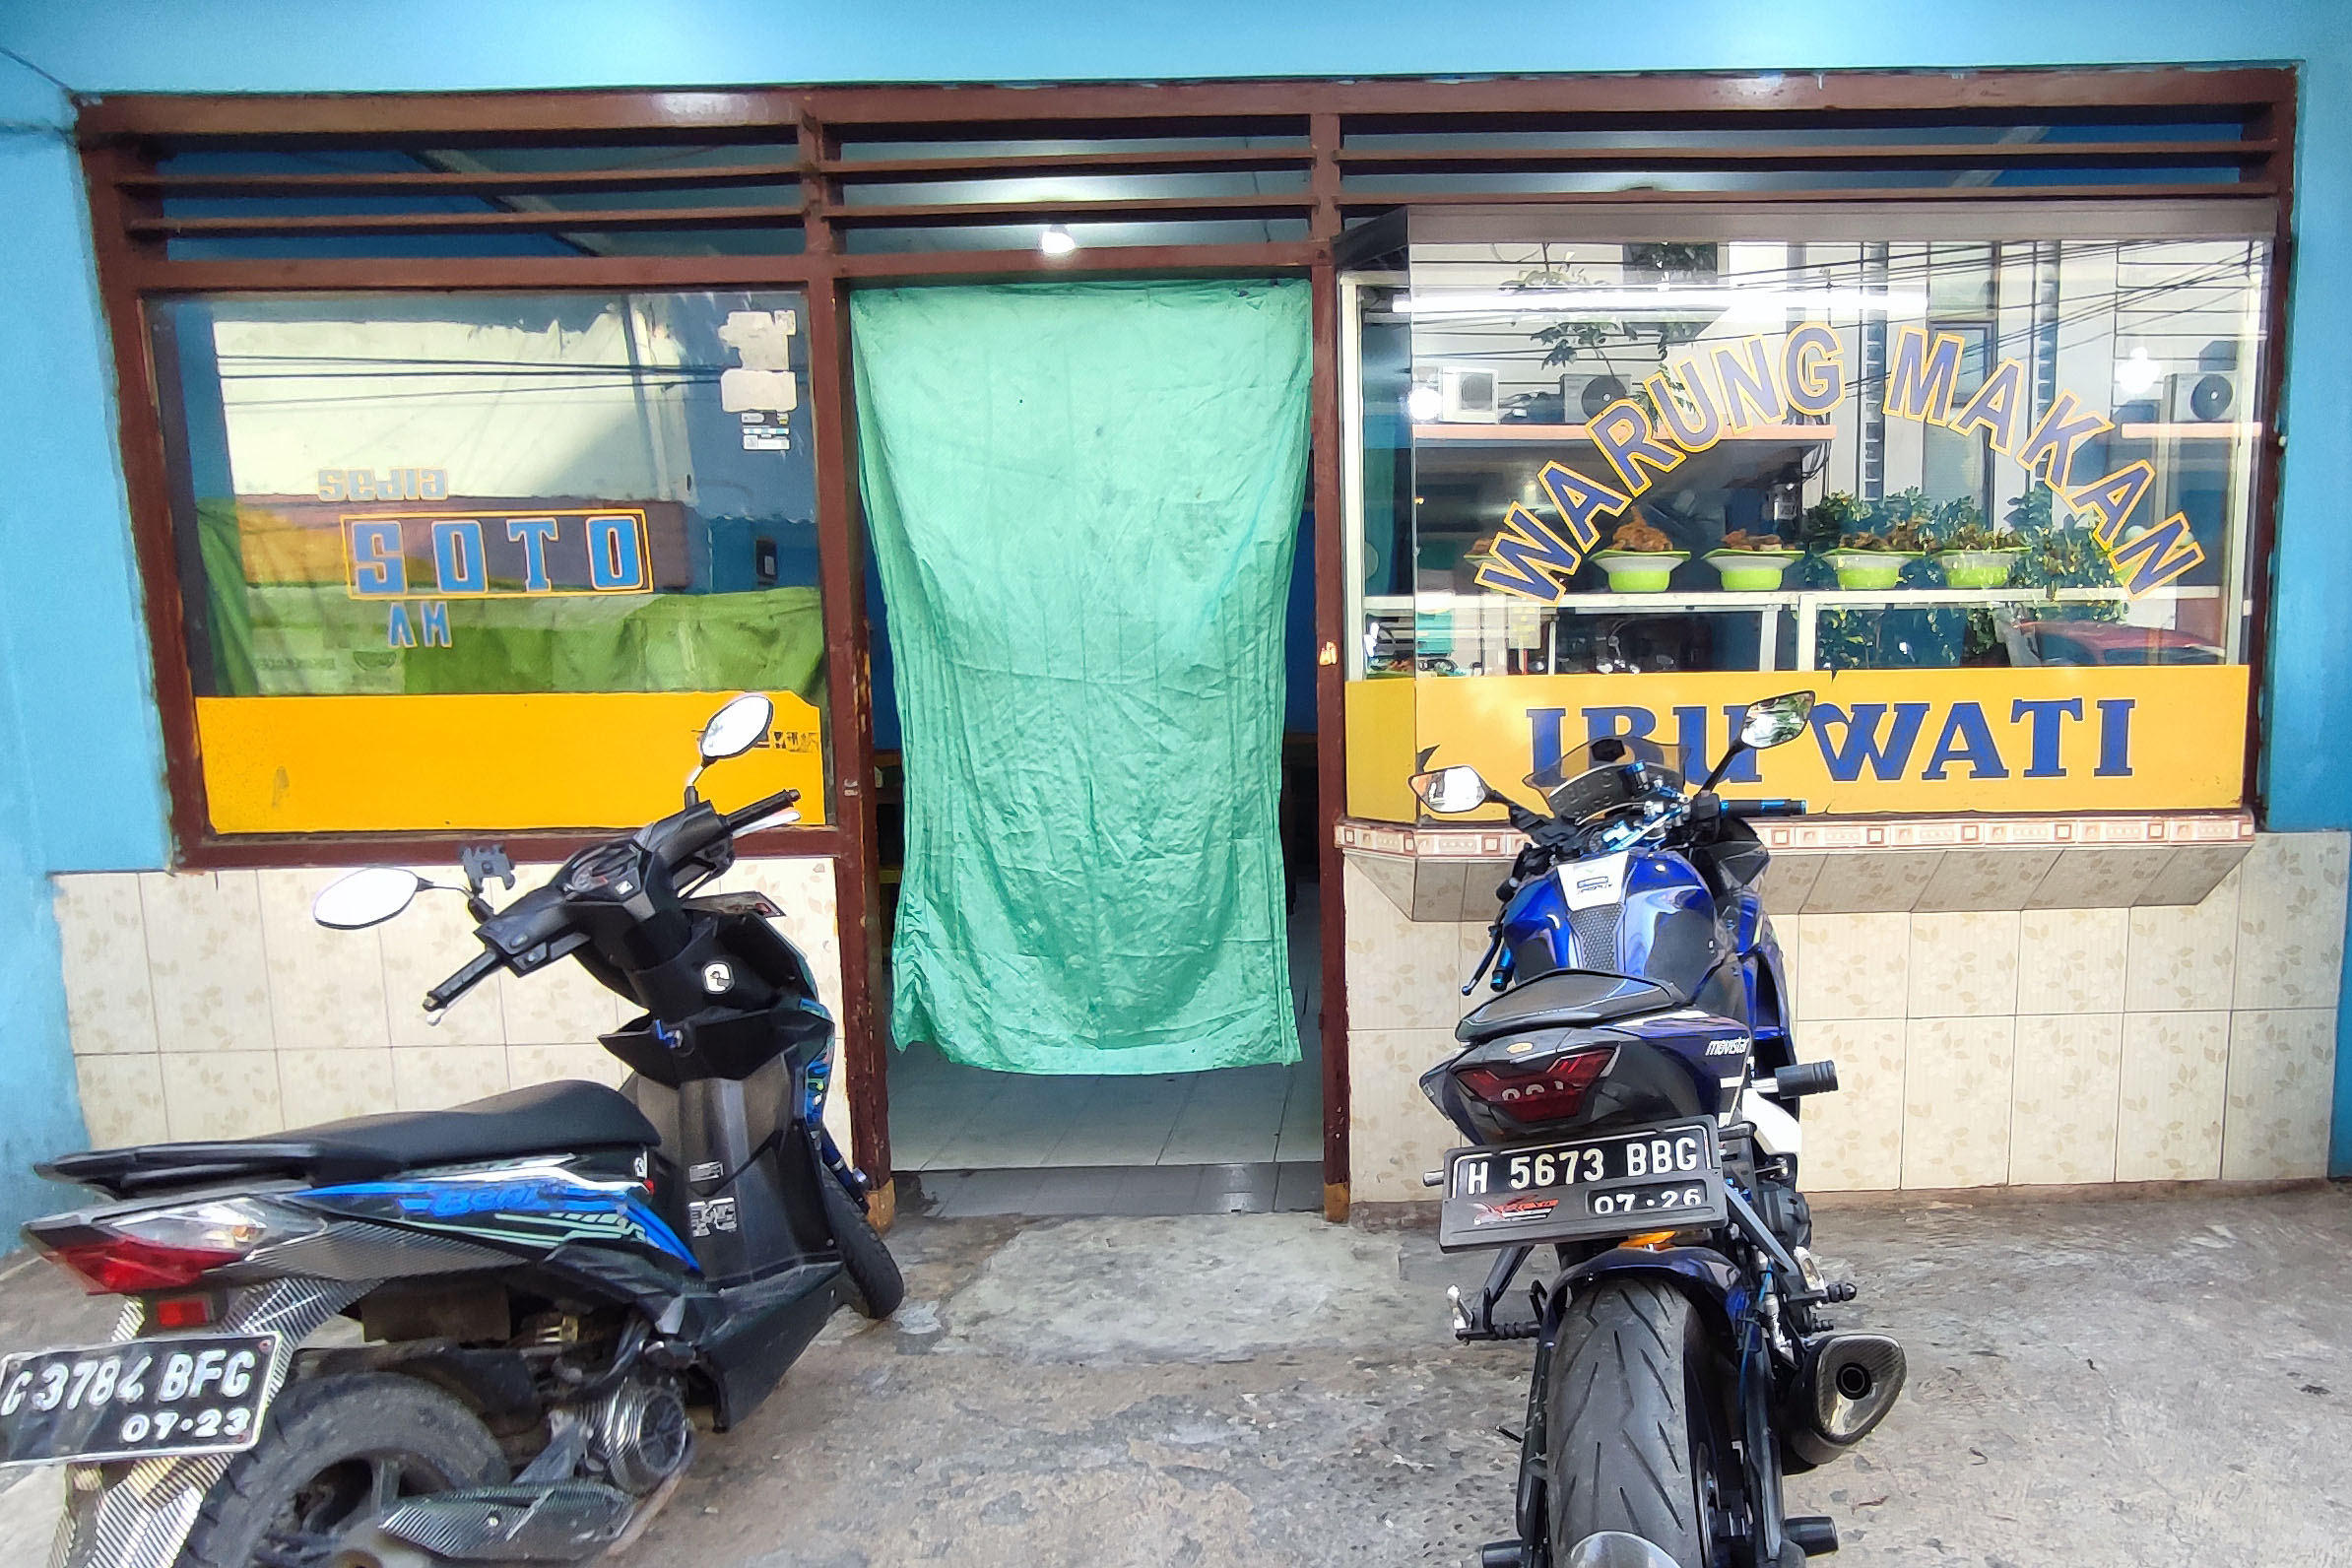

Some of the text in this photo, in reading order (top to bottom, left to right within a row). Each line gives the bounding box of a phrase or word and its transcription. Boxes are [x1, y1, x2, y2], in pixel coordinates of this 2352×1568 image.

[1473, 321, 2206, 606] WARUNG MAKAN
[352, 516, 644, 594] SOTO
[1526, 697, 2136, 787] IBU WATI
[1705, 1036, 1750, 1056] movistar
[1467, 1137, 1698, 1195] H 5673 BBG
